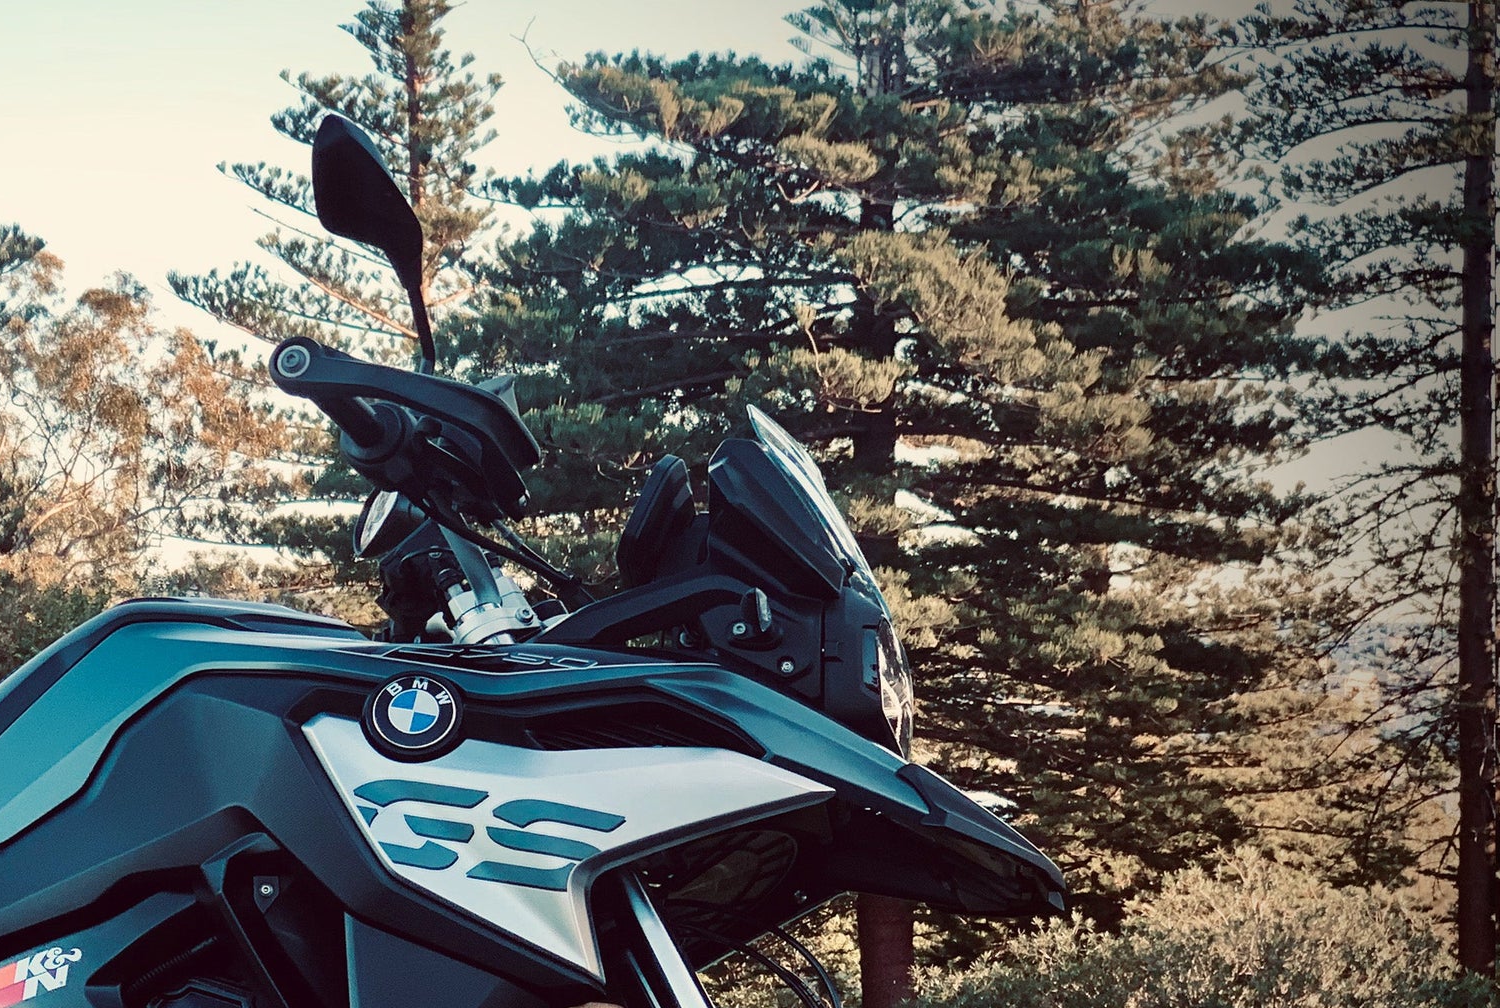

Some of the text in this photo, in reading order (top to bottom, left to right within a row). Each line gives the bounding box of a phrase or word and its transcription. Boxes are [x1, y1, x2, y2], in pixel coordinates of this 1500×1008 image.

[386, 678, 453, 706] BMW
[353, 778, 627, 892] GS
[13, 946, 83, 1001] K&N
